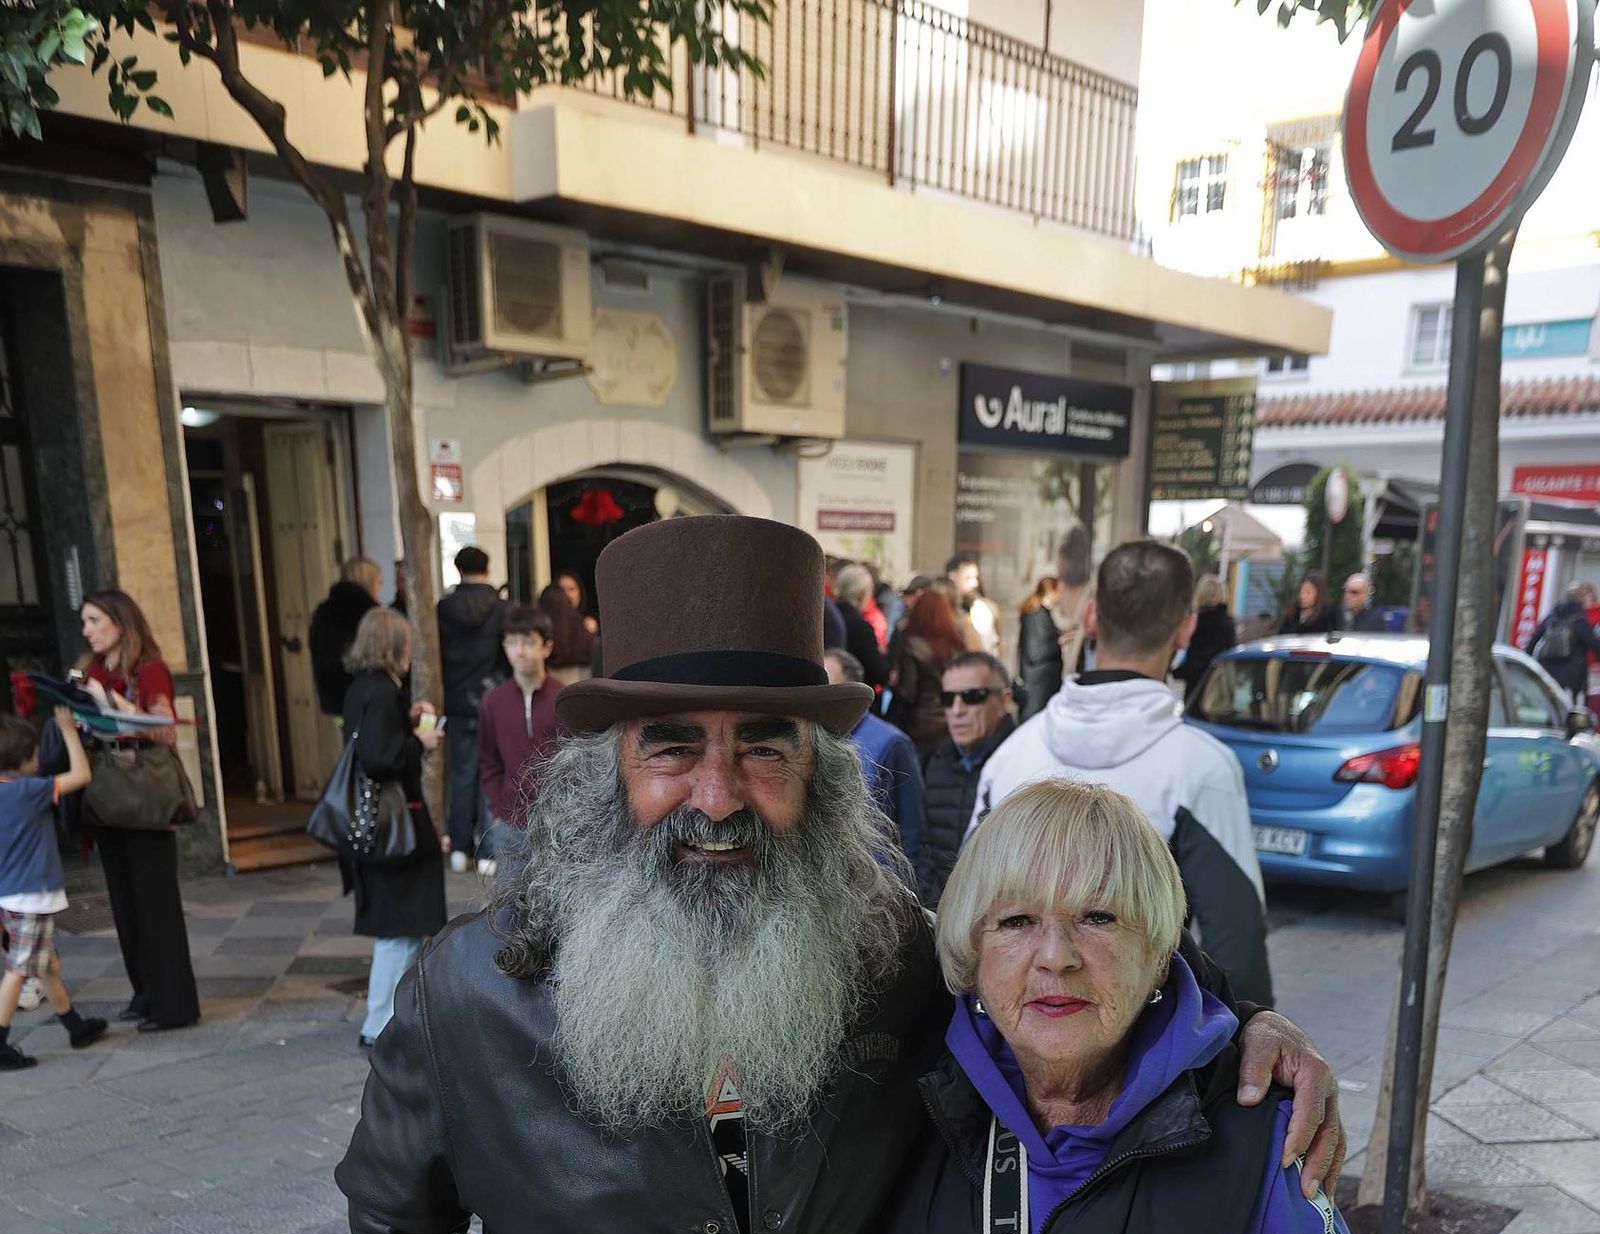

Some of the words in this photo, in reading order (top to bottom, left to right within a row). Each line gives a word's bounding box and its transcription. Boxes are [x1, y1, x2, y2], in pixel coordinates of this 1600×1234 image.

[1391, 31, 1512, 153] 20
[1003, 384, 1067, 436] Aural
[994, 1119, 1017, 1174] US
